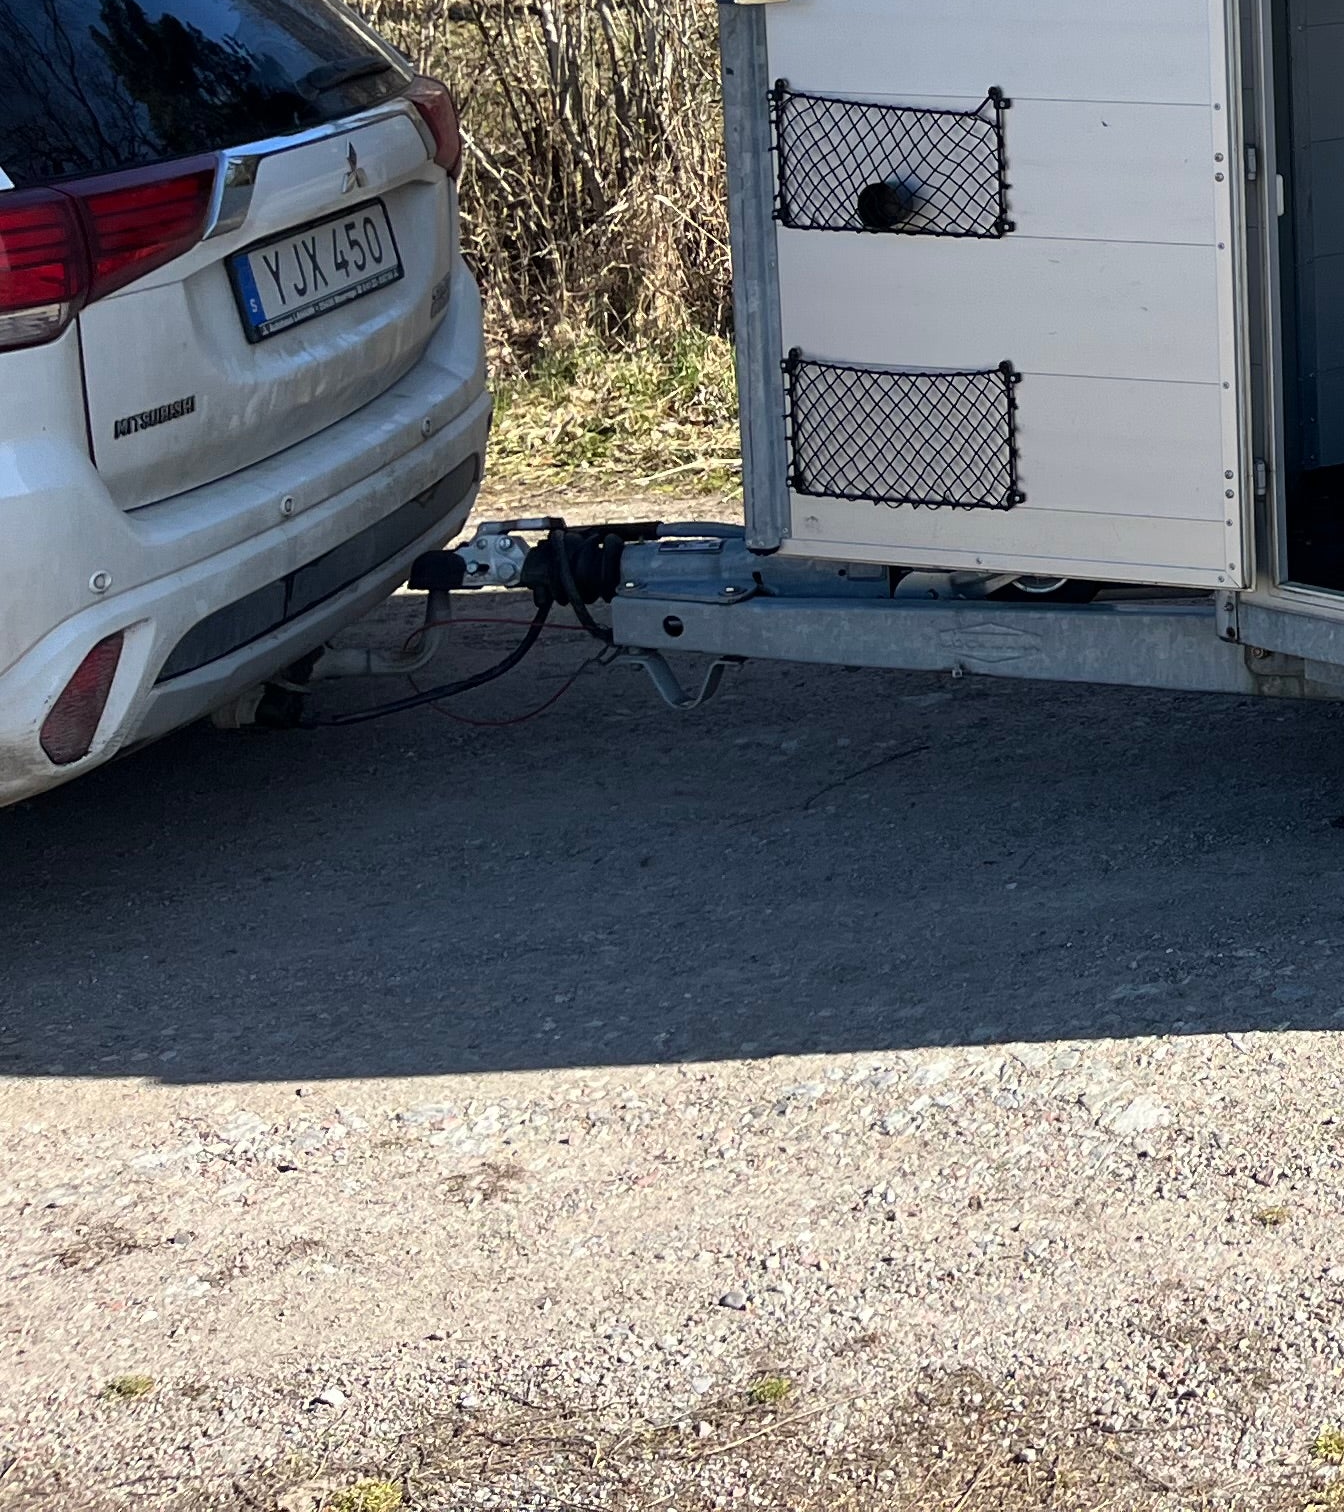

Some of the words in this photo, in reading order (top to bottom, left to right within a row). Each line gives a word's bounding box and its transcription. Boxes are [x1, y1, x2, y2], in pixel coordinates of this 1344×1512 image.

[262, 235, 329, 305] YJX
[331, 216, 384, 279] 450
[250, 298, 258, 313] S
[113, 394, 196, 440] MITSUBISHI
